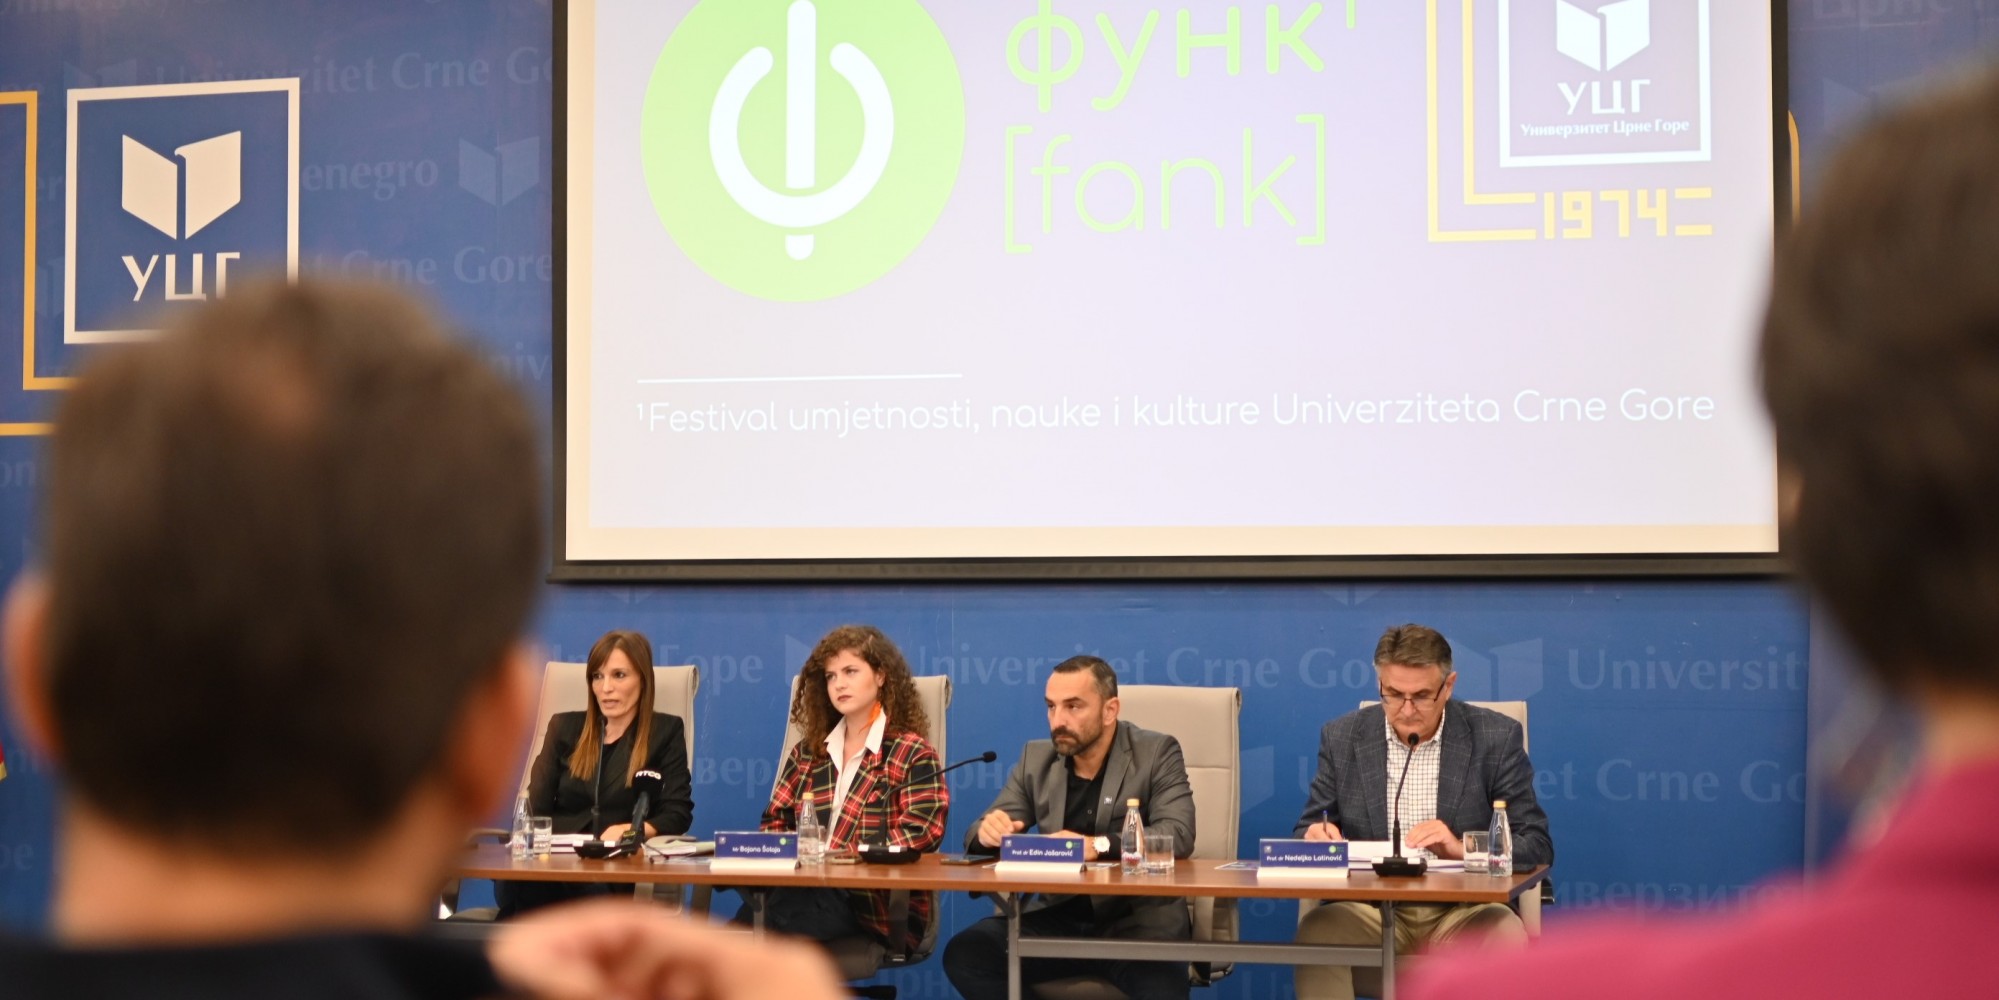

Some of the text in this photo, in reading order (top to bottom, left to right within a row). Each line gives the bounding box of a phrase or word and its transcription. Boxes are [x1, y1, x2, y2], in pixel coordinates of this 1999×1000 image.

[1557, 79, 1651, 115] УЦГ
[1520, 118, 1690, 138] Универзитет Црне Горе
[1544, 188, 1668, 240] 1974
[121, 251, 241, 302] УЦГ
[788, 398, 980, 438] umjetnosti,
[991, 396, 1101, 429] nauke
[1113, 396, 1119, 427] i
[1132, 395, 1260, 427] kulture
[1271, 392, 1501, 425] Univerziteta
[1513, 390, 1606, 423] Crne
[1619, 388, 1715, 421] Gore
